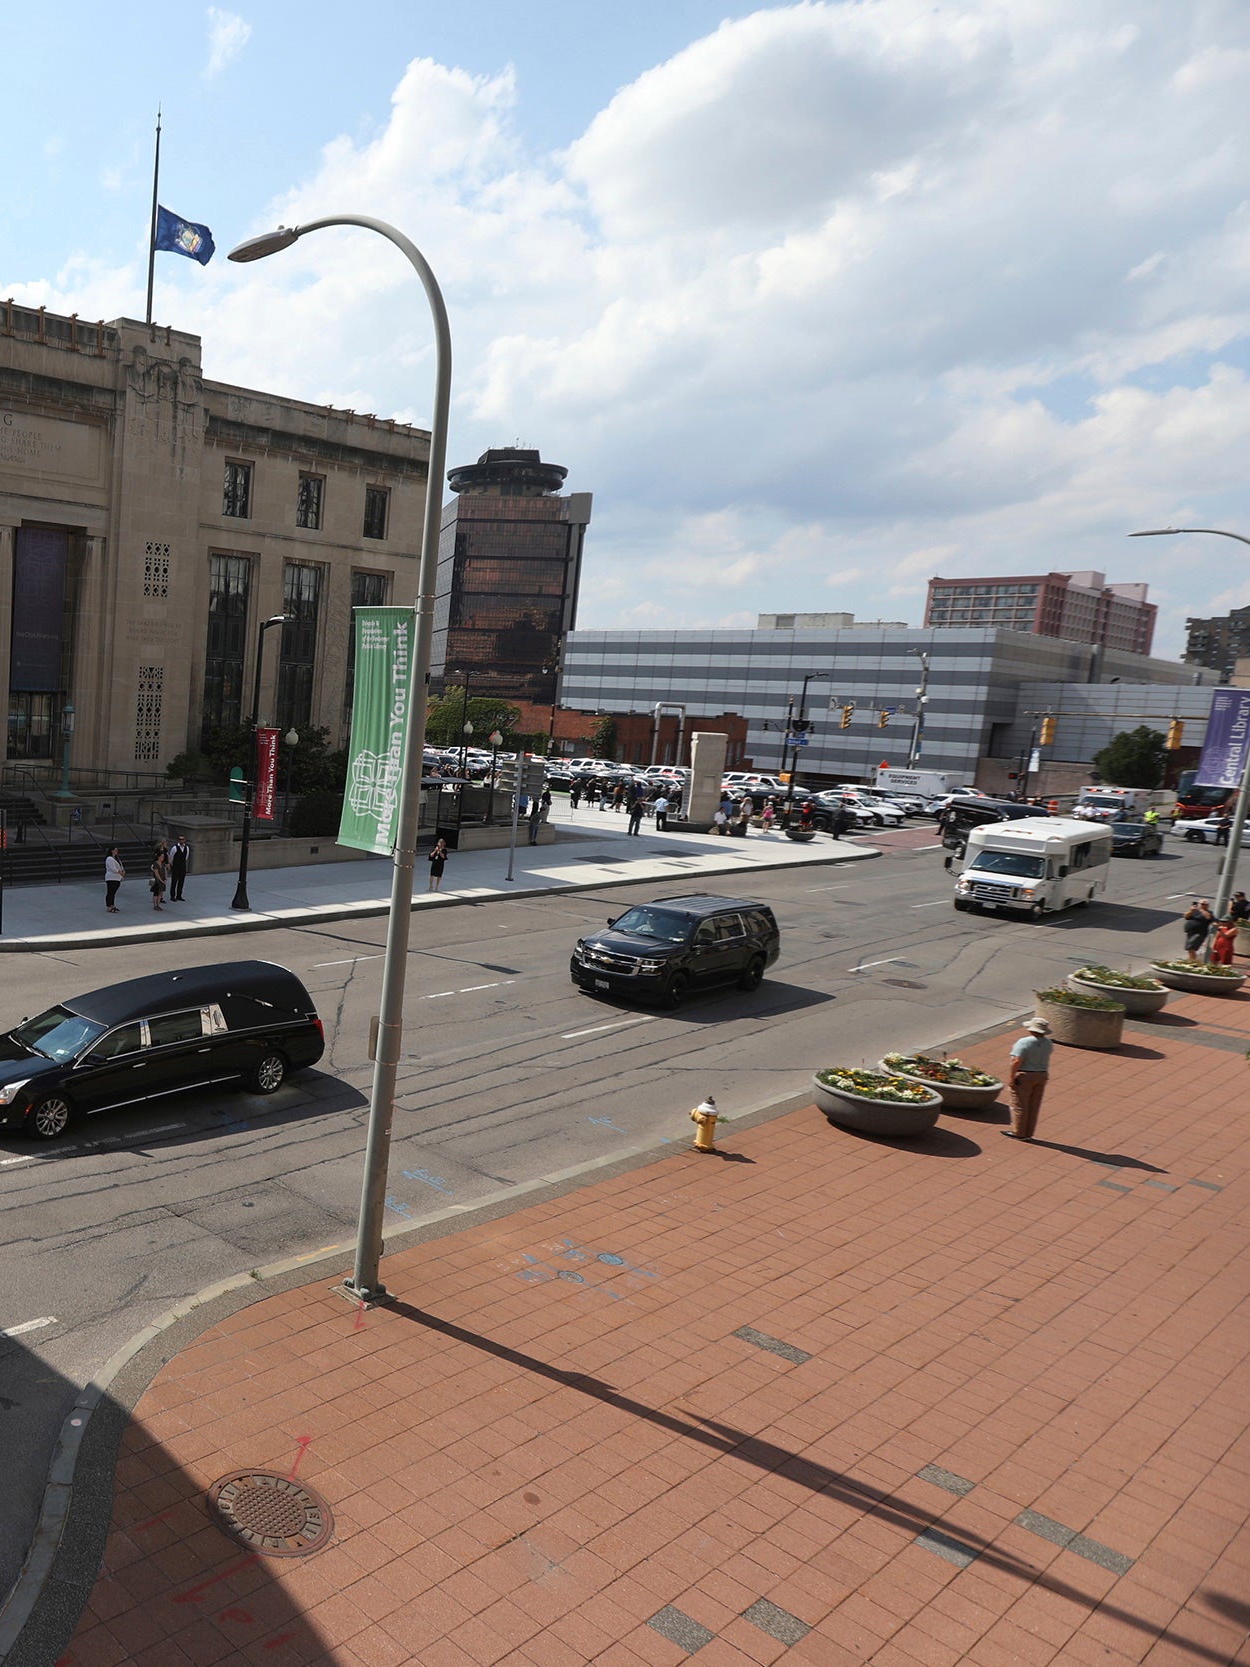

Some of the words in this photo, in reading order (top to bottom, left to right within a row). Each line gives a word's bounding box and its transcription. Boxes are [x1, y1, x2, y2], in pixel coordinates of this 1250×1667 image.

[11, 429, 42, 440] PEOPLE
[392, 621, 408, 684] Think
[390, 686, 407, 727] You
[1230, 696, 1250, 739] Library
[269, 734, 277, 758] Think
[385, 731, 403, 783] Than
[1220, 742, 1243, 785] Central
[375, 782, 398, 844] More
